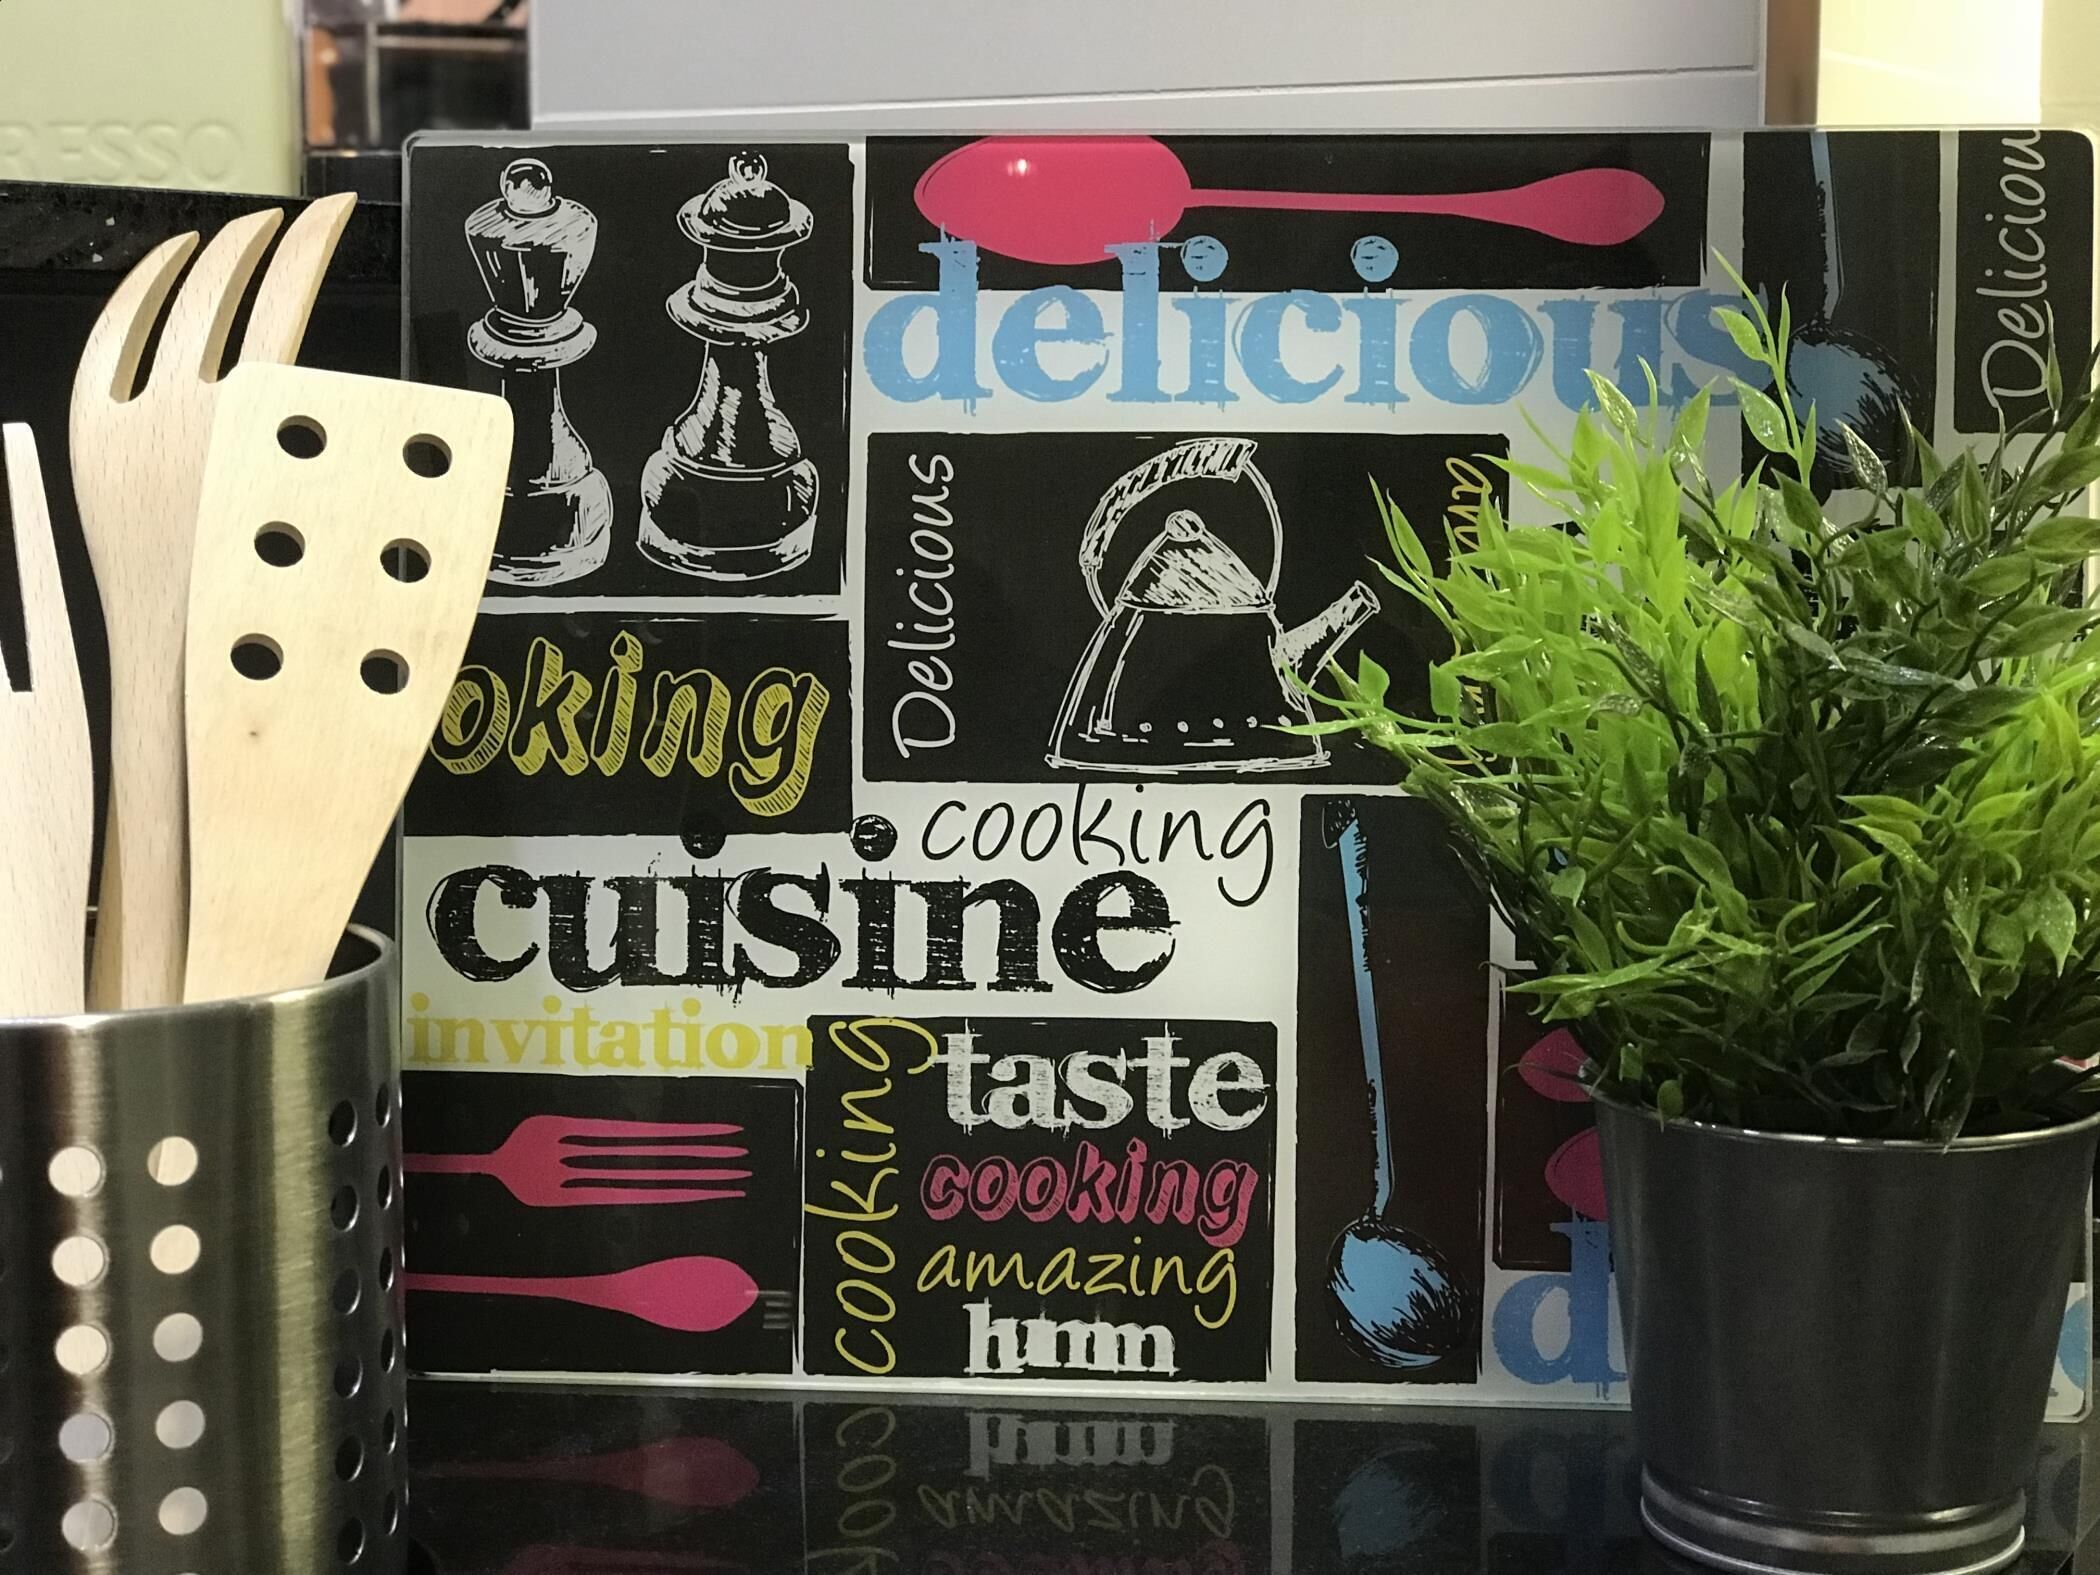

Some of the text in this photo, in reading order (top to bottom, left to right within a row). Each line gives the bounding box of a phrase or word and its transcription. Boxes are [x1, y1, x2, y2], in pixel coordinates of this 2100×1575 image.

[862, 218, 1772, 417] delicious
[888, 453, 957, 759] Delicious
[428, 629, 830, 817] oking
[426, 812, 1181, 1007] cuisine
[921, 780, 1273, 906] cooking
[406, 992, 814, 1073] invitation
[927, 1019, 1271, 1139] taste
[803, 1016, 939, 1375] cooking
[920, 1137, 1258, 1248] cooking
[917, 1236, 1237, 1329] amazing
